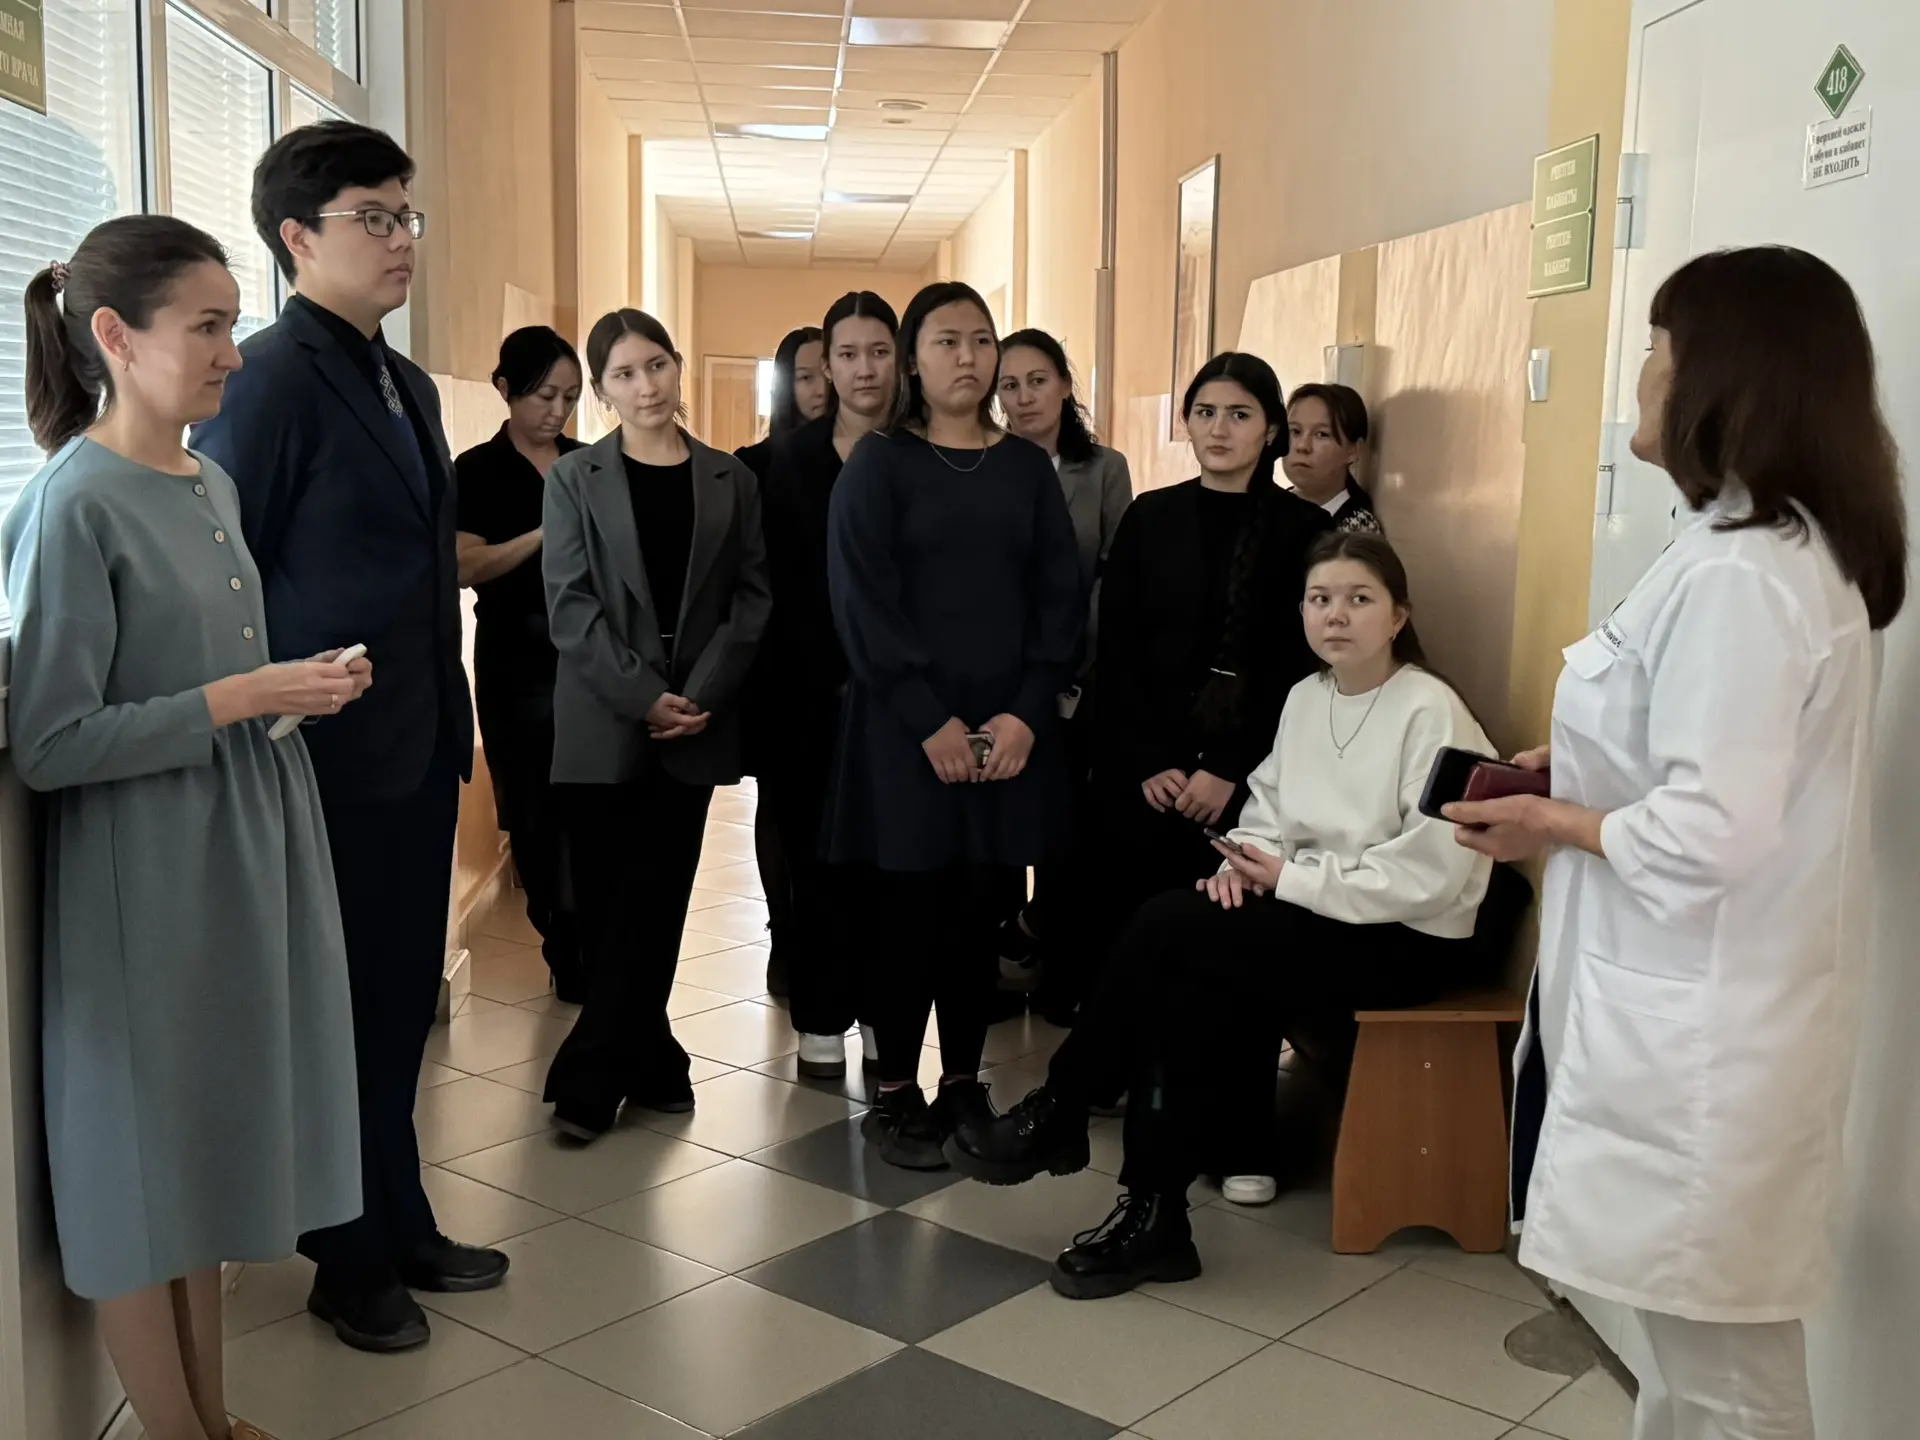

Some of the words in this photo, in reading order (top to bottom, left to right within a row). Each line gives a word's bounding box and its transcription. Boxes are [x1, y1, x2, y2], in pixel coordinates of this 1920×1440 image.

[11, 56, 39, 87] ВРАЧА
[1826, 66, 1849, 96] 418
[1813, 165, 1824, 179] НЕ
[1824, 155, 1860, 176] ВХОДИТЬ
